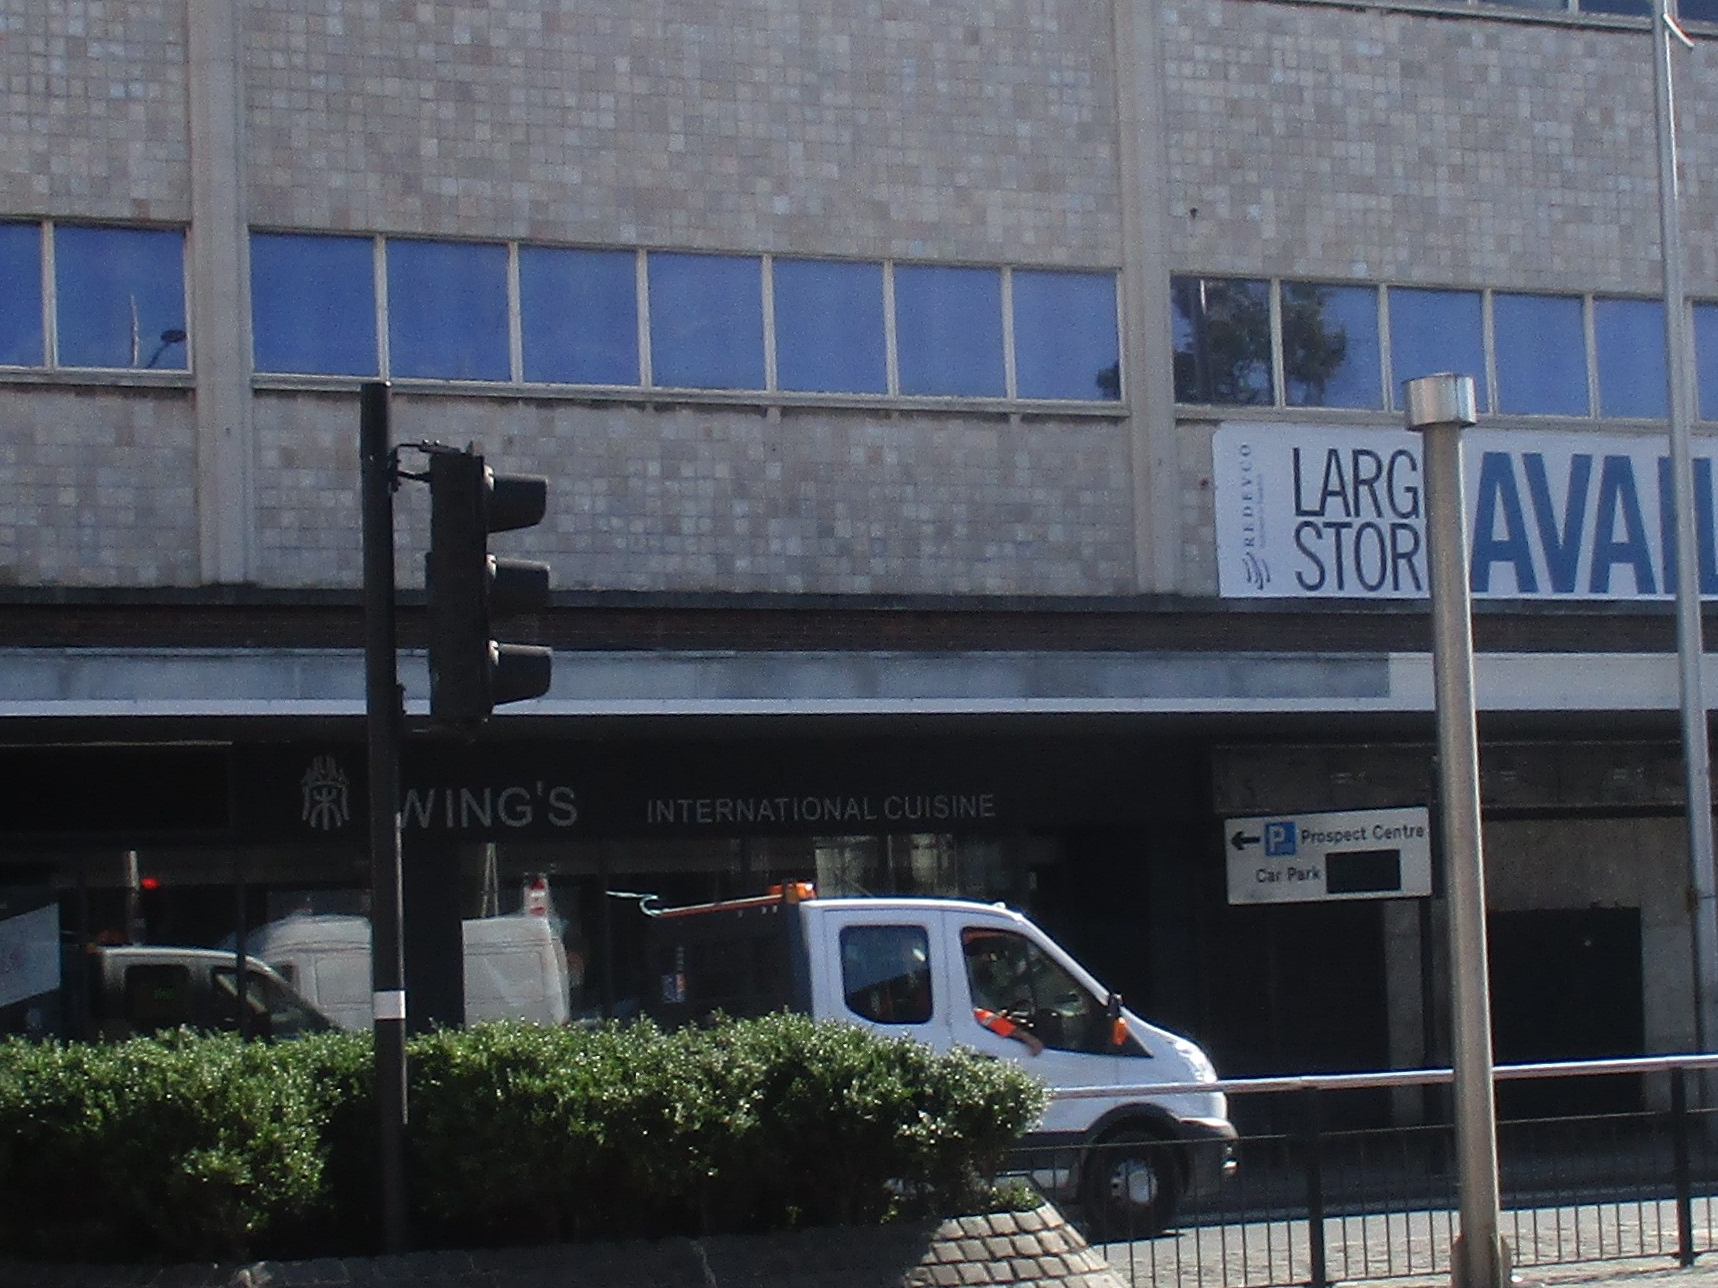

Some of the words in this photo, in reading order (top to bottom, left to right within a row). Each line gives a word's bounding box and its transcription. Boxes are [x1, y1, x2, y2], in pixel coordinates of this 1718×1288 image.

[1240, 444, 1254, 547] REDEVCO
[1291, 446, 1420, 519] LARG
[1293, 520, 1423, 592] STOR
[398, 780, 579, 829] WING'S
[646, 795, 878, 824] INTERNATIONAL
[883, 793, 995, 820] CUISINE
[1301, 826, 1367, 845] Prospect
[1372, 823, 1425, 840] Centre
[1256, 868, 1282, 883] Car
[1287, 866, 1321, 882] Park
